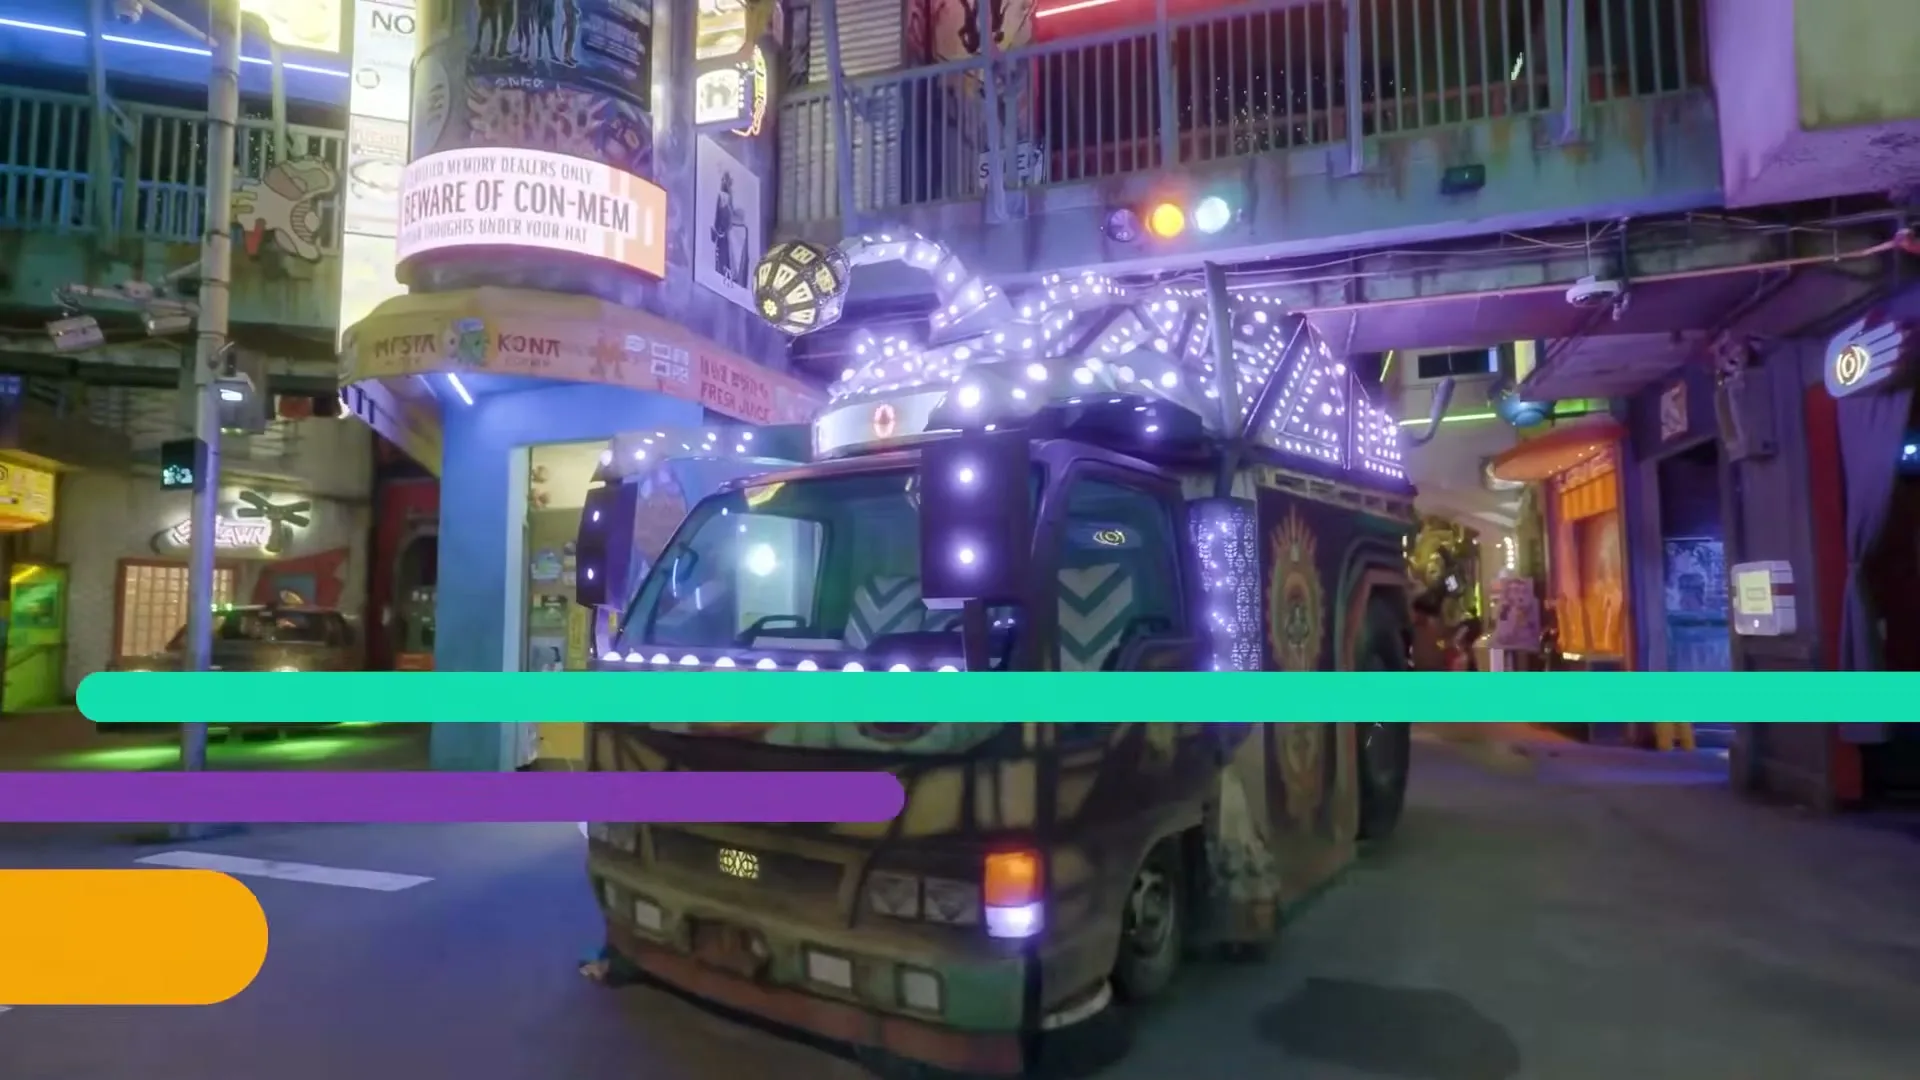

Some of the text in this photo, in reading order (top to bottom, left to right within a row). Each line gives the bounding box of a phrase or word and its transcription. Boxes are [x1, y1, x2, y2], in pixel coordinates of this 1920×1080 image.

[447, 156, 496, 174] MEMORY
[501, 156, 556, 177] DEALERS
[561, 163, 593, 184] ONLY
[404, 179, 630, 234] BEWARE OF CON-MEM
[479, 217, 521, 236] UNDER
[526, 219, 561, 239] YOUR
[565, 225, 588, 244] HAT
[700, 380, 737, 410] FRESH
[738, 399, 771, 424] JUICE
